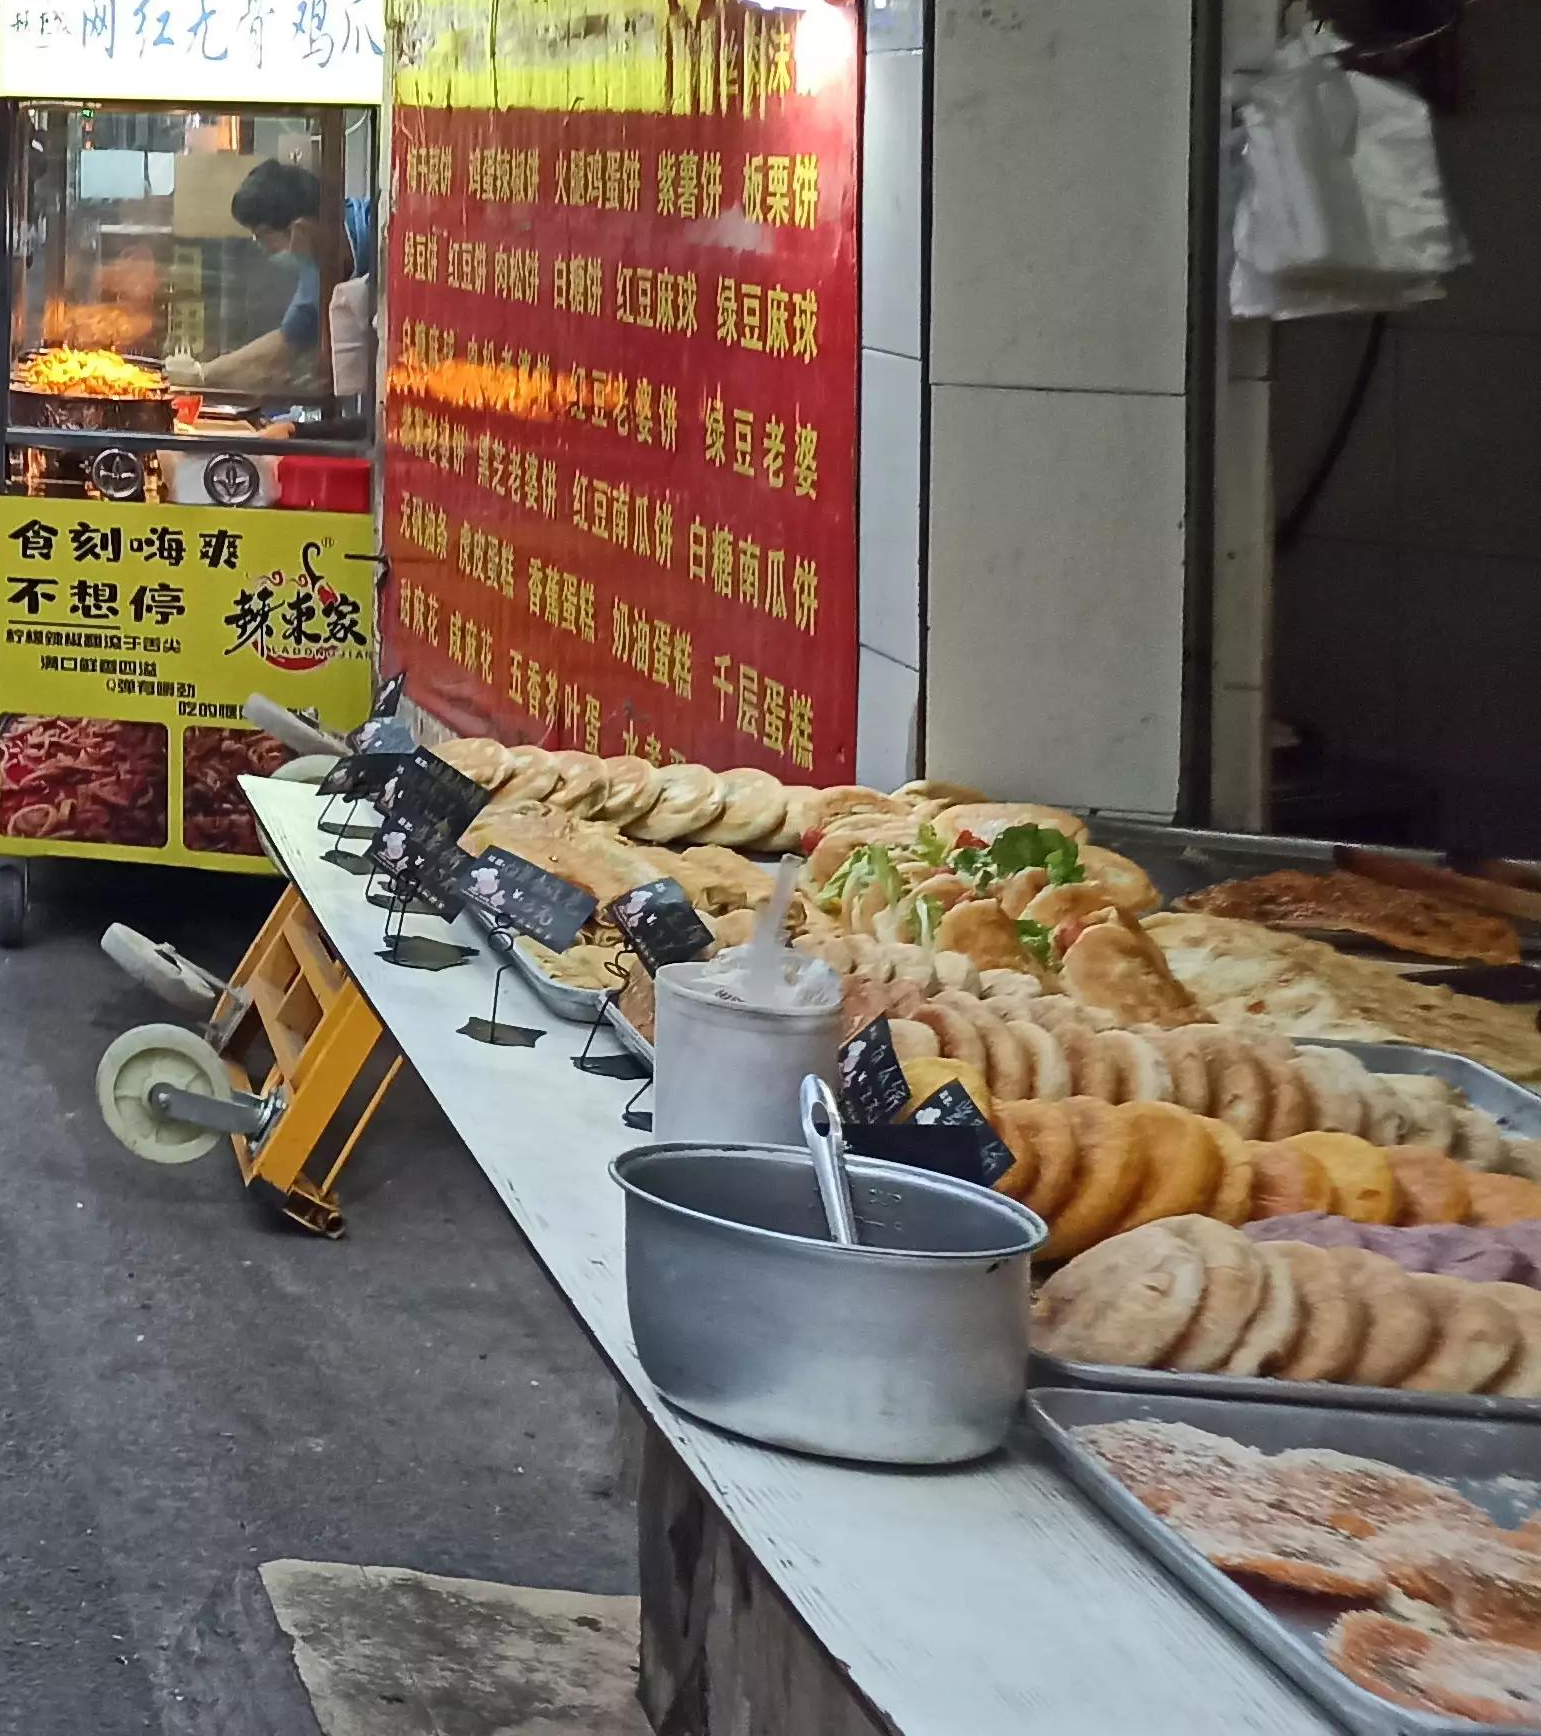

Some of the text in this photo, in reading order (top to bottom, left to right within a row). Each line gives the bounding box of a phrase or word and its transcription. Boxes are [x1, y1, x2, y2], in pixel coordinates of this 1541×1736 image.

[554, 148, 641, 211] 火腿鸡蛋饼
[657, 149, 723, 220] 紫薯饼
[743, 151, 818, 231] 板栗饼
[403, 230, 818, 364] 绿豆饼 红豆饼 肉松饼 白糖饼 红豆麻球 绿豆麻球
[570, 360, 677, 453] 红豆老婆饼
[704, 384, 818, 501] 绿豆老婆
[6, 576, 187, 625] 不想停
[8, 519, 244, 571] 食刻嗨爽
[572, 468, 674, 570] 红豆南瓜饼
[689, 514, 818, 637] 白糖南瓜饼
[458, 519, 515, 600] 虎皮蛋糕
[527, 556, 596, 644] 香蕉蛋糕
[612, 595, 693, 700] 奶油蛋糕
[713, 654, 814, 772] 千层蛋糕
